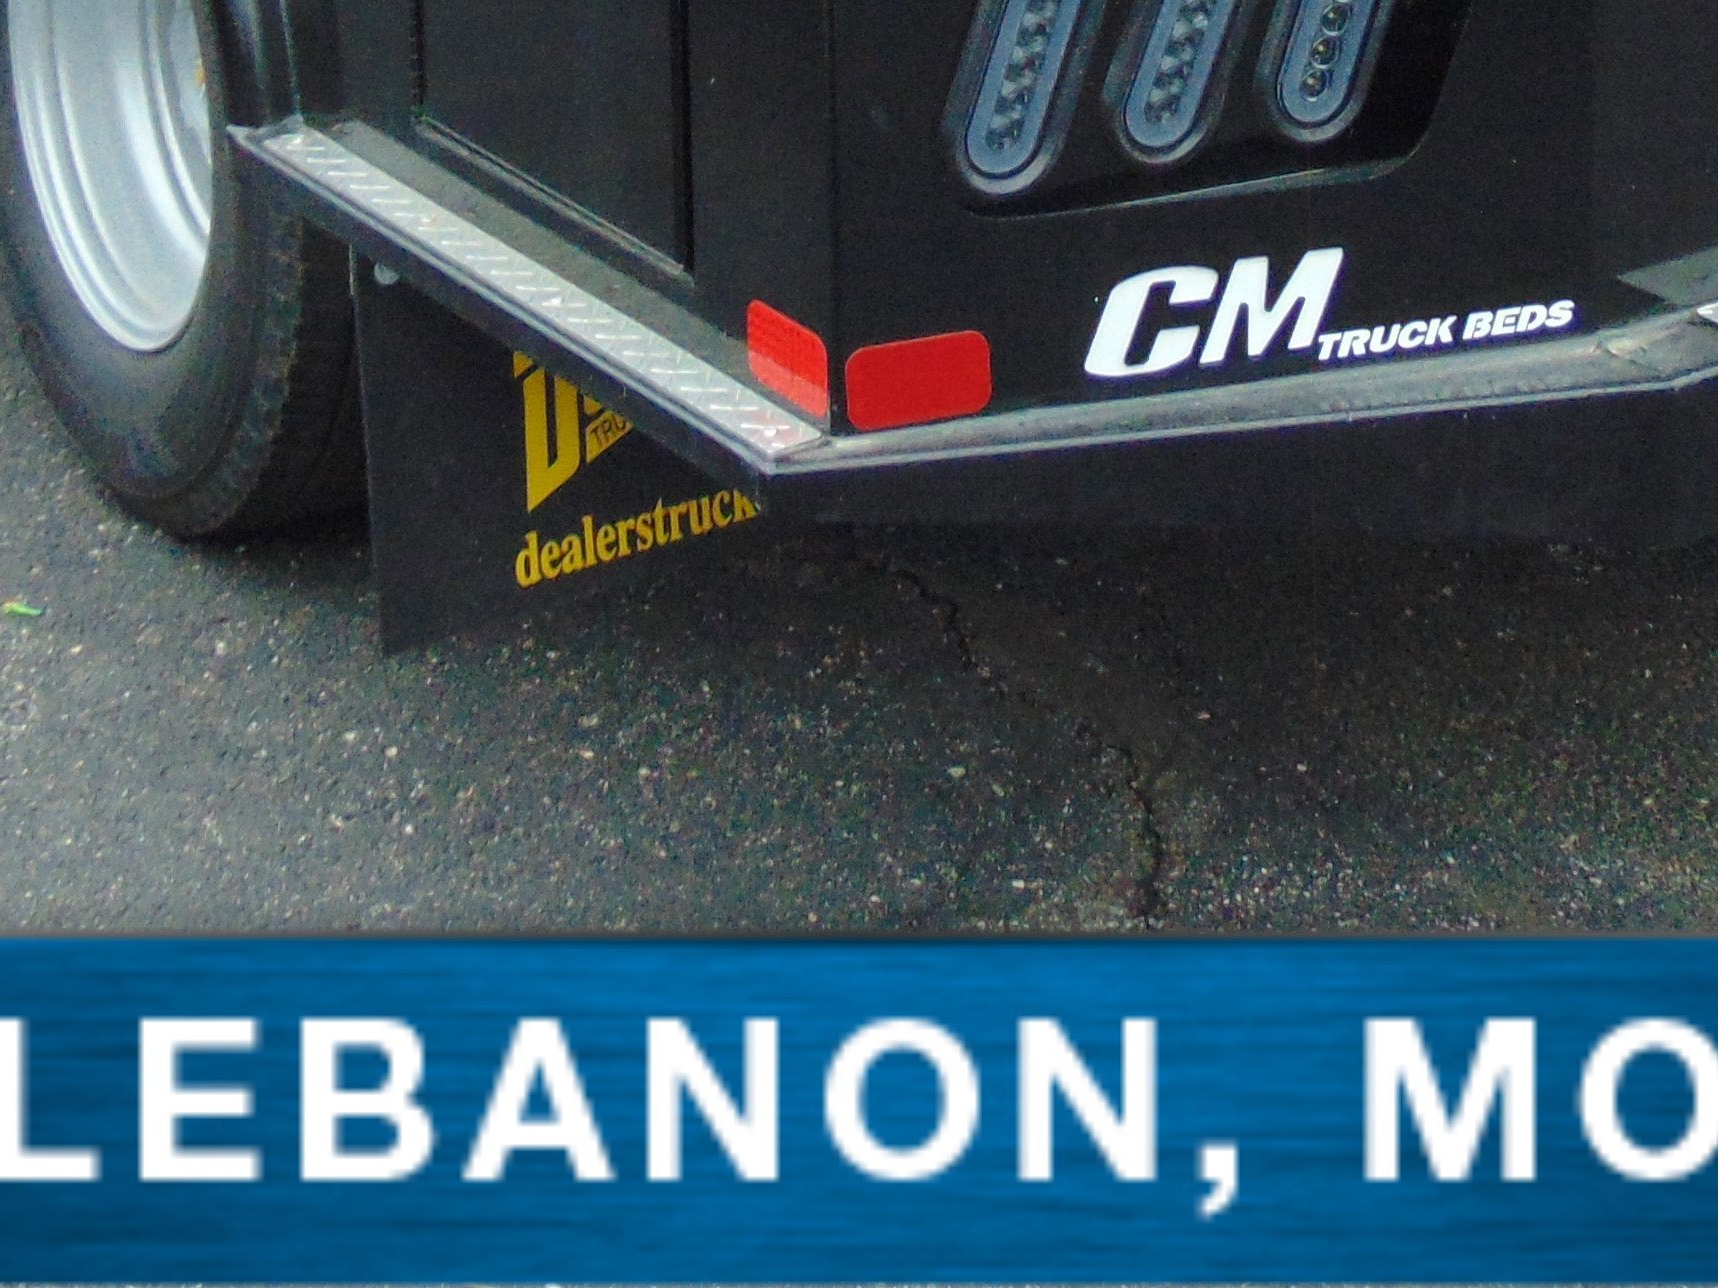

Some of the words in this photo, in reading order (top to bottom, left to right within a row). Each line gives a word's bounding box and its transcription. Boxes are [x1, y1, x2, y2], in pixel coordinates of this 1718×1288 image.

[1083, 246, 1345, 378] CM
[1317, 315, 1459, 361] TRUCK
[1461, 298, 1576, 341] BEDS
